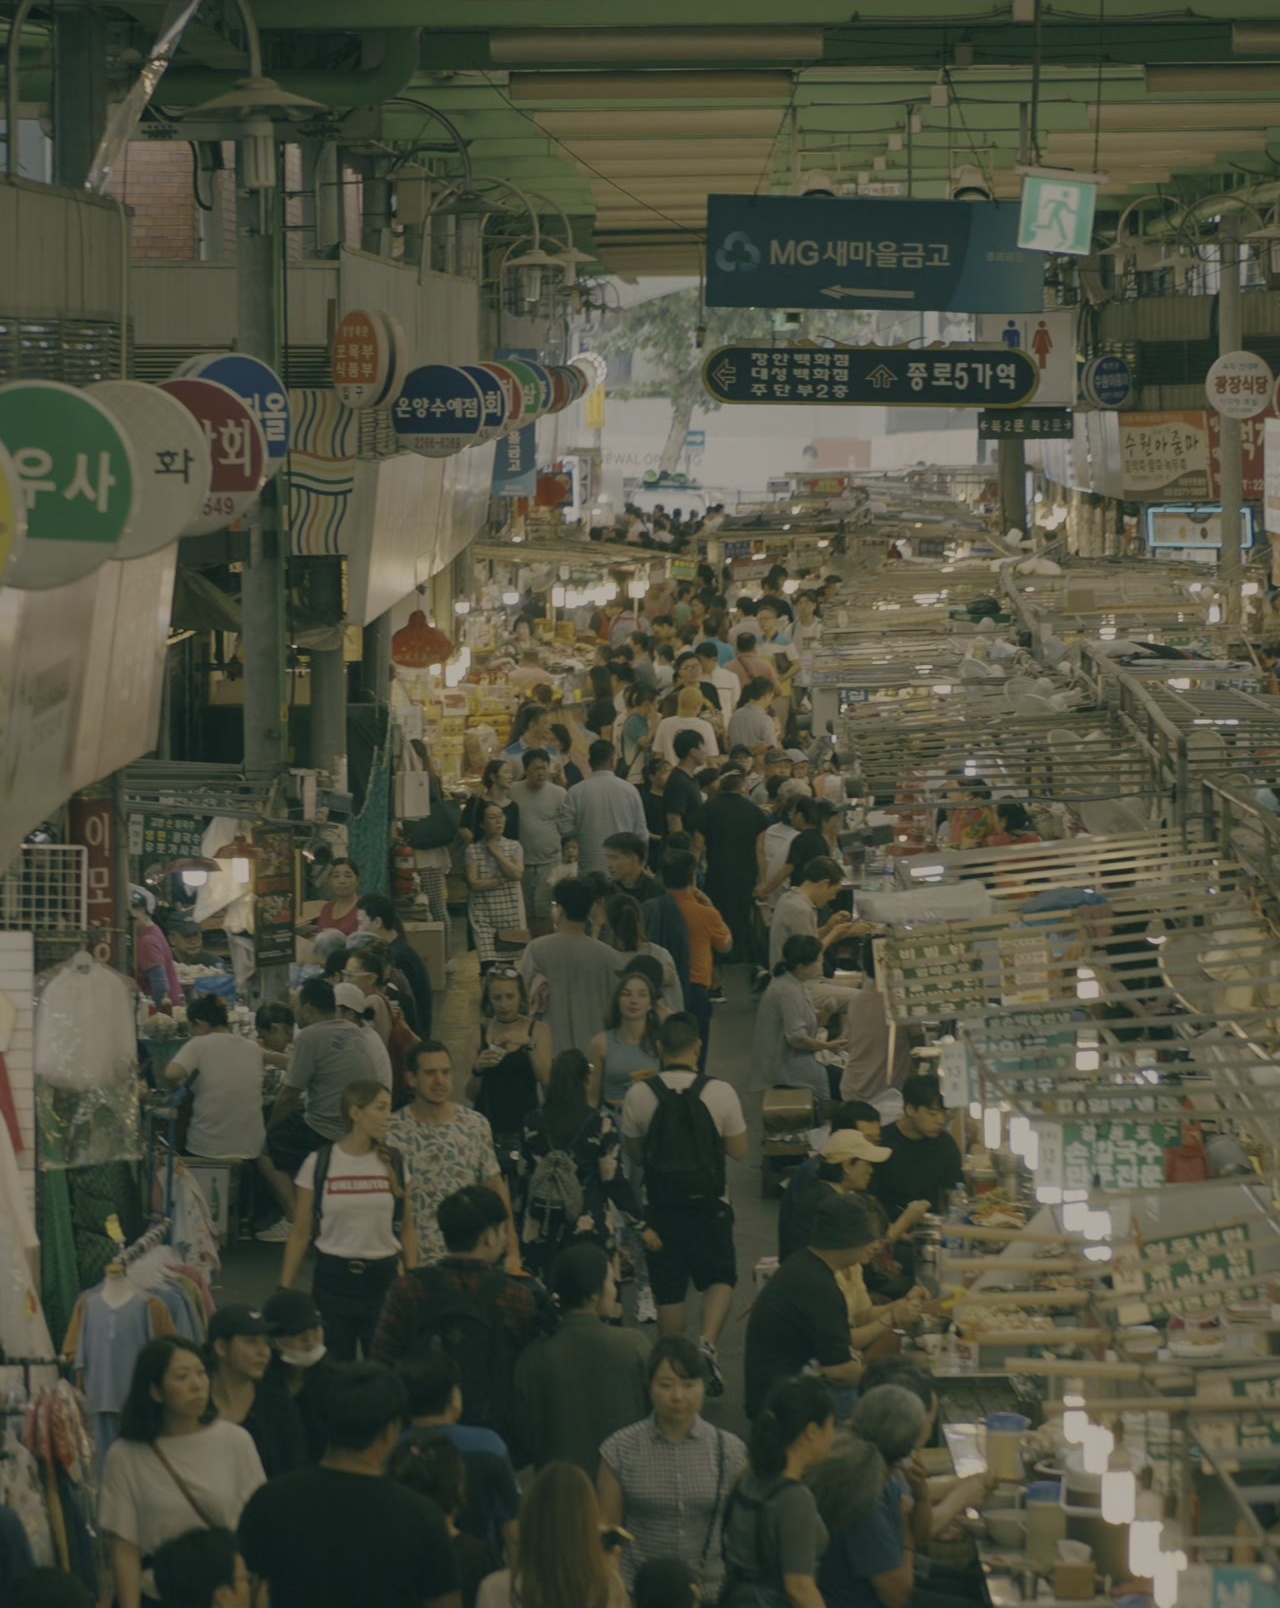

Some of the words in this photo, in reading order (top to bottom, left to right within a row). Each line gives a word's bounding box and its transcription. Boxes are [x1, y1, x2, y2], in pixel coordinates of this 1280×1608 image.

[336, 362, 374, 378] 식품부
[751, 353, 850, 367] 장안백화점
[907, 362, 1016, 391] 종로5가역
[1214, 375, 1269, 395] 광장식당
[396, 397, 479, 418] 온양수예점
[204, 417, 253, 477] 회
[1124, 430, 1200, 457] 수원아줌마
[153, 449, 195, 484] 화
